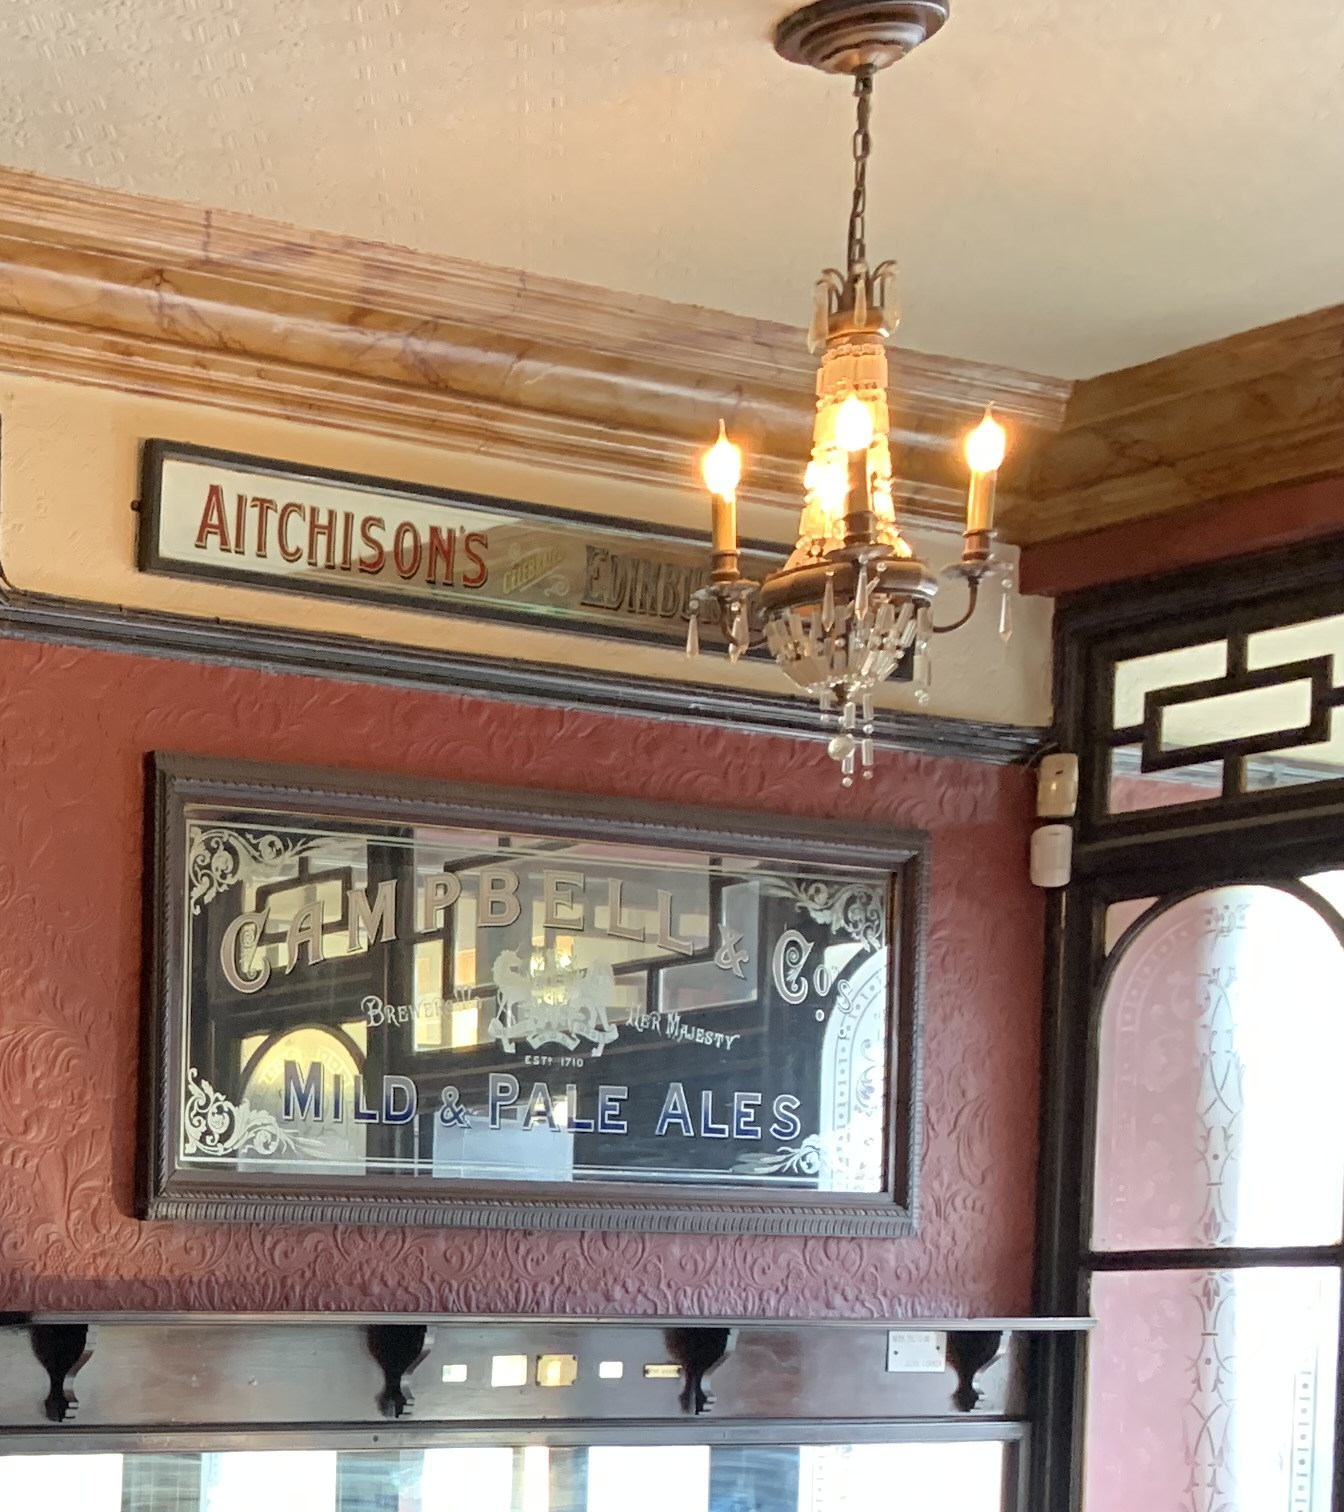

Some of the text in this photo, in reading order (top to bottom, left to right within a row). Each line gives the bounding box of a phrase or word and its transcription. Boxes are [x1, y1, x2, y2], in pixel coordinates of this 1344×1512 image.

[194, 484, 488, 589] AITCHISON'S
[220, 866, 748, 995] CAMPBELL &
[561, 1056, 584, 1068] 1710
[626, 1005, 661, 1031] HER
[665, 1014, 740, 1051] MAJESTY
[282, 1059, 802, 1140] MILD & PALE ALES
